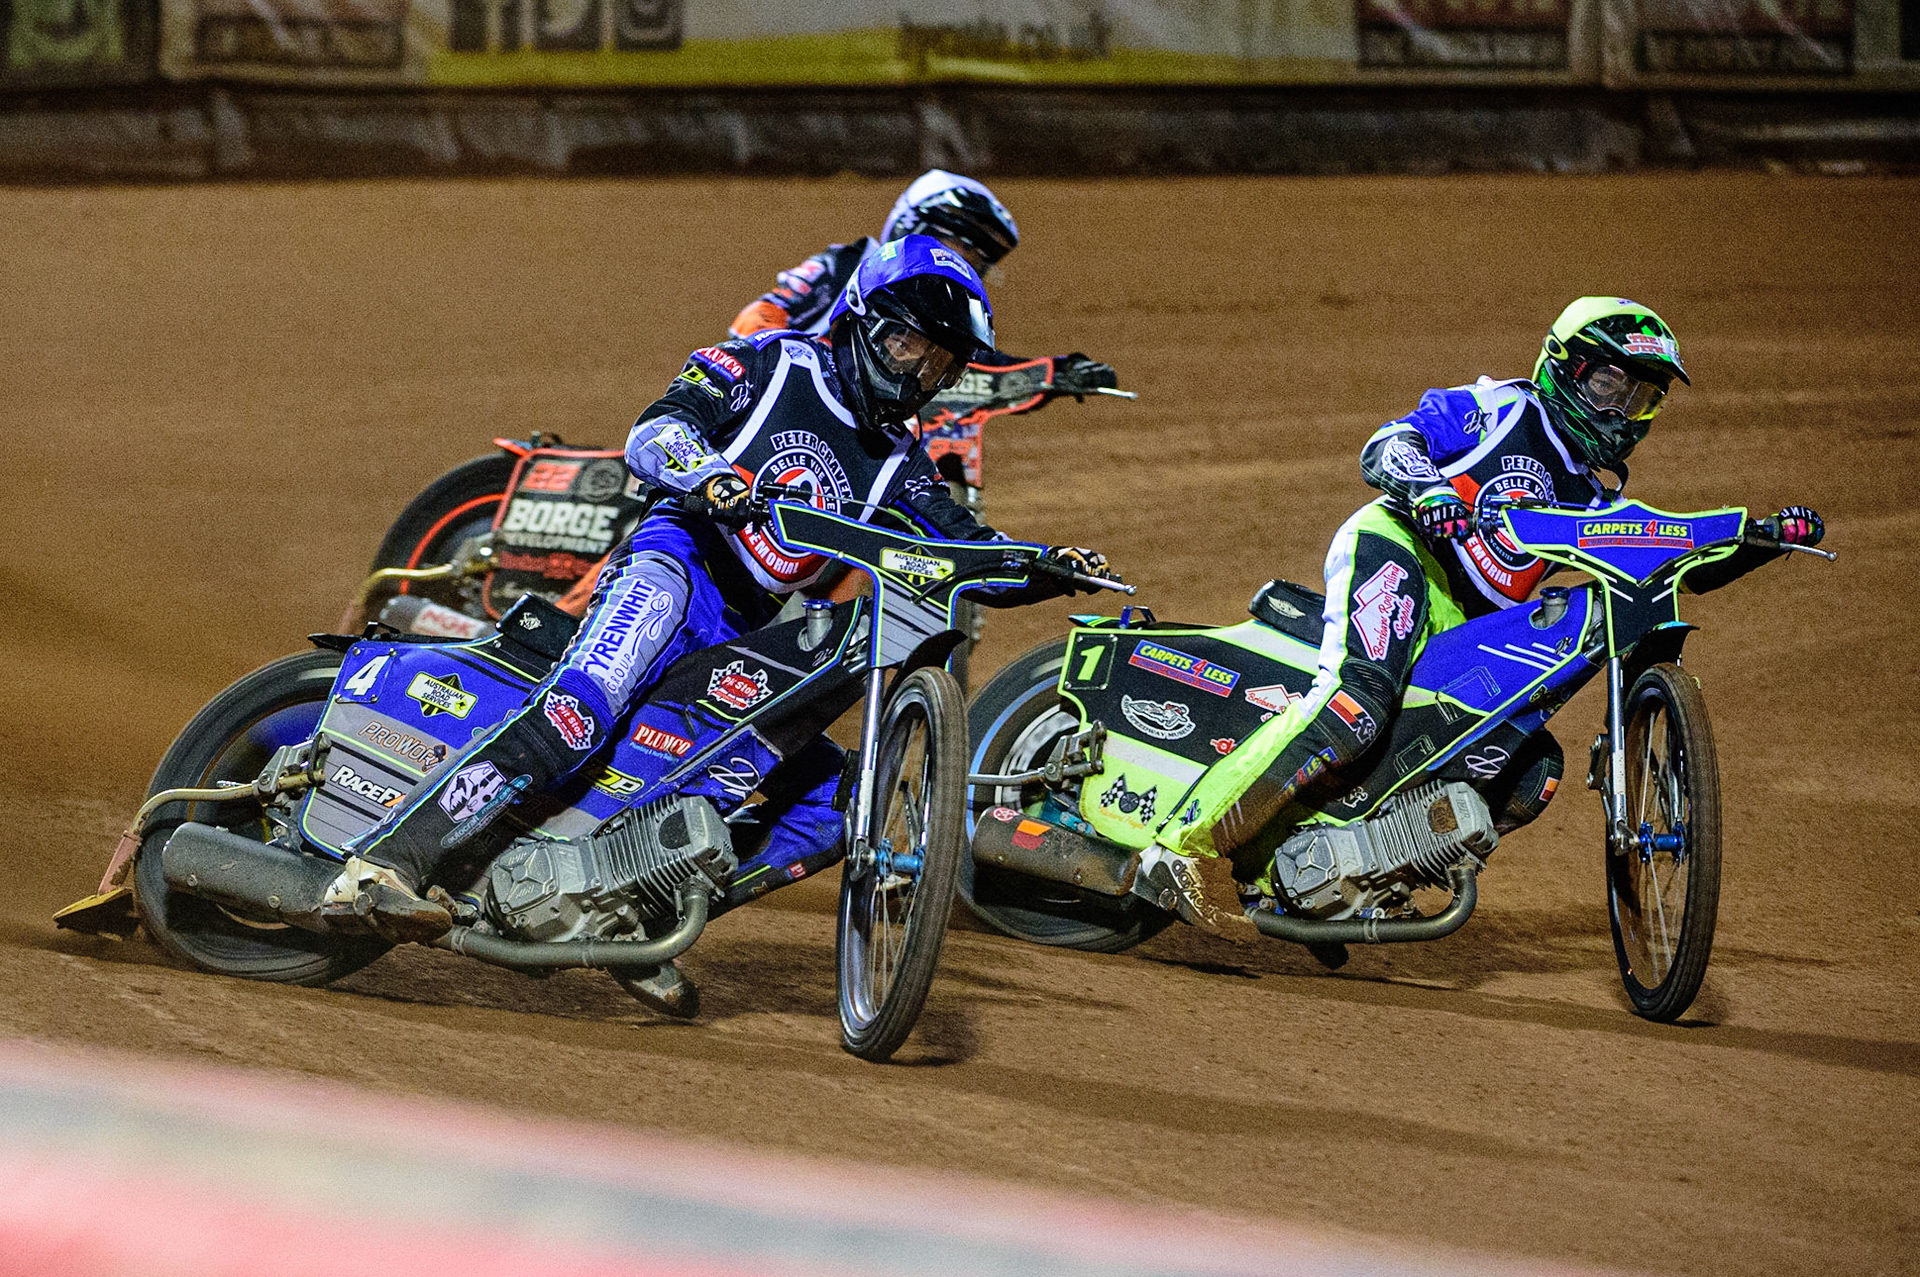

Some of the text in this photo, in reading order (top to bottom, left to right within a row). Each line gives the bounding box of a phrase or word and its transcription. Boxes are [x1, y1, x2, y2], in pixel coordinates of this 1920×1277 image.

[523, 462, 581, 491] 22
[770, 430, 854, 504] PETER CRAVEN
[1501, 455, 1545, 479] PETER
[770, 455, 836, 514] BELLE VUE ACE
[1494, 478, 1545, 500] BELLE VU
[502, 499, 619, 542] BORGE
[1583, 519, 1688, 538] CARPETS 4 LESS
[893, 552, 941, 567] AUSTRALIAN
[899, 564, 933, 576] SERVICES
[904, 560, 927, 570] ROAD
[1466, 535, 1512, 587] EMORIAL
[606, 653, 635, 692] GROUP
[1076, 644, 1106, 681] 1
[1139, 644, 1194, 671] CARPETS
[1191, 659, 1208, 678] 4
[1203, 666, 1234, 685] LESS
[344, 655, 390, 696] 4
[421, 692, 451, 709] SERVICES
[424, 679, 465, 700] AUSTRALIAN
[430, 689, 451, 701] ROAD
[734, 681, 757, 697] Stop
[1247, 692, 1276, 710] Brisbane
[556, 704, 570, 718] Pit
[567, 716, 584, 738] Stop
[1168, 723, 1194, 738] MUSEUM
[633, 725, 691, 755] PLUMCO
